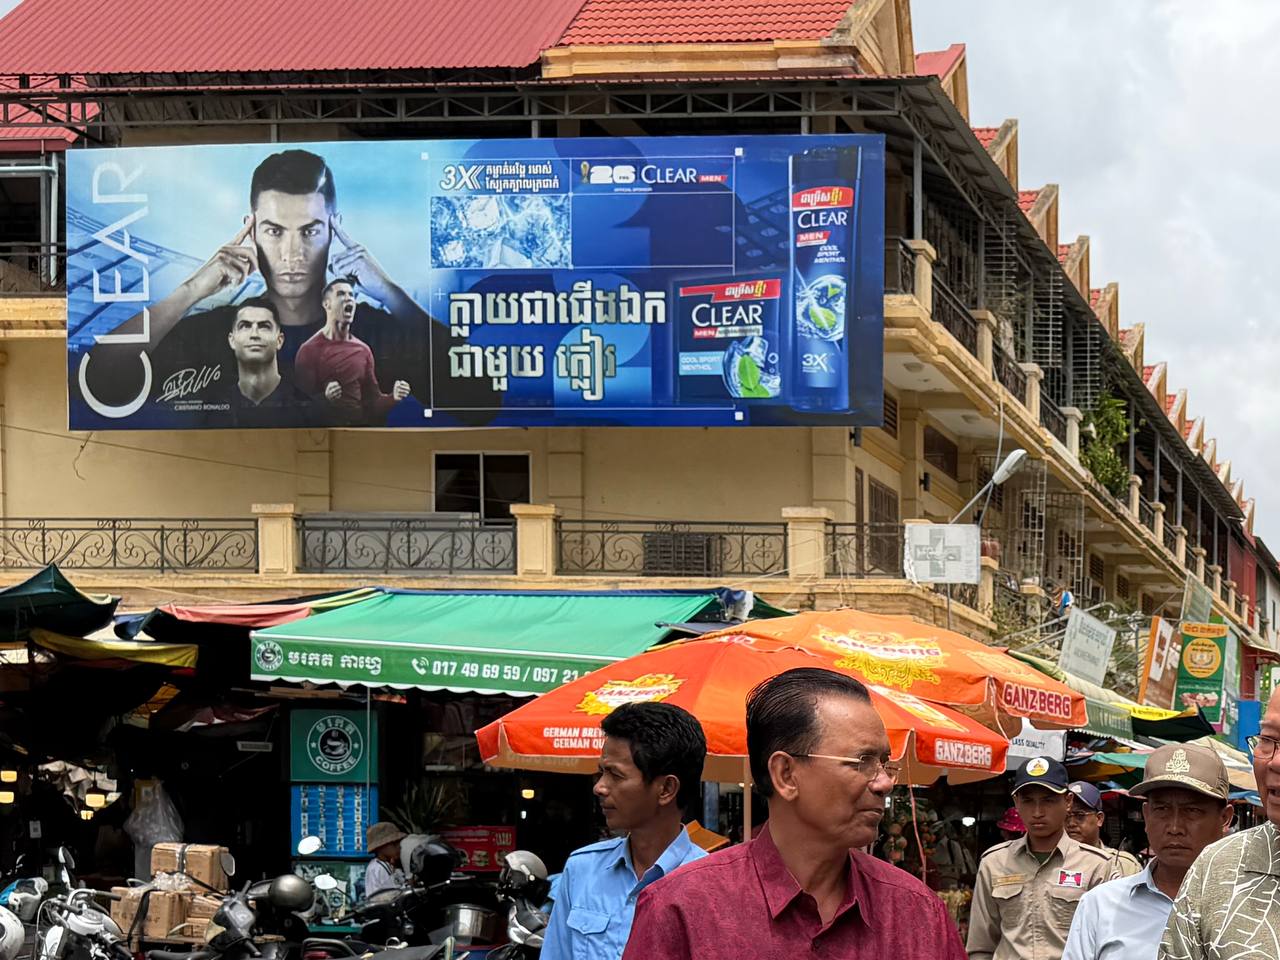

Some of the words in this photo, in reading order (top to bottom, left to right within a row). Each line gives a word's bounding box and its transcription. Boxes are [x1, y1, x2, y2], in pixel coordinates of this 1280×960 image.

[440, 164, 480, 191] 3X
[640, 165, 697, 184] CLEAR
[797, 211, 847, 229] CLEAR
[799, 232, 824, 241] MEN
[78, 160, 153, 419] CLEAR
[691, 303, 763, 327] CLEAR
[431, 660, 457, 676] 017
[460, 662, 479, 678] 49
[482, 663, 500, 679] 69
[503, 665, 521, 681] 59
[532, 667, 559, 684] 097
[1003, 682, 1071, 718] GANZBERG
[543, 727, 580, 738] GERMAN
[553, 738, 590, 749] GERMAN
[935, 738, 993, 768] GANZBERG
[315, 755, 357, 772] COFFEE
